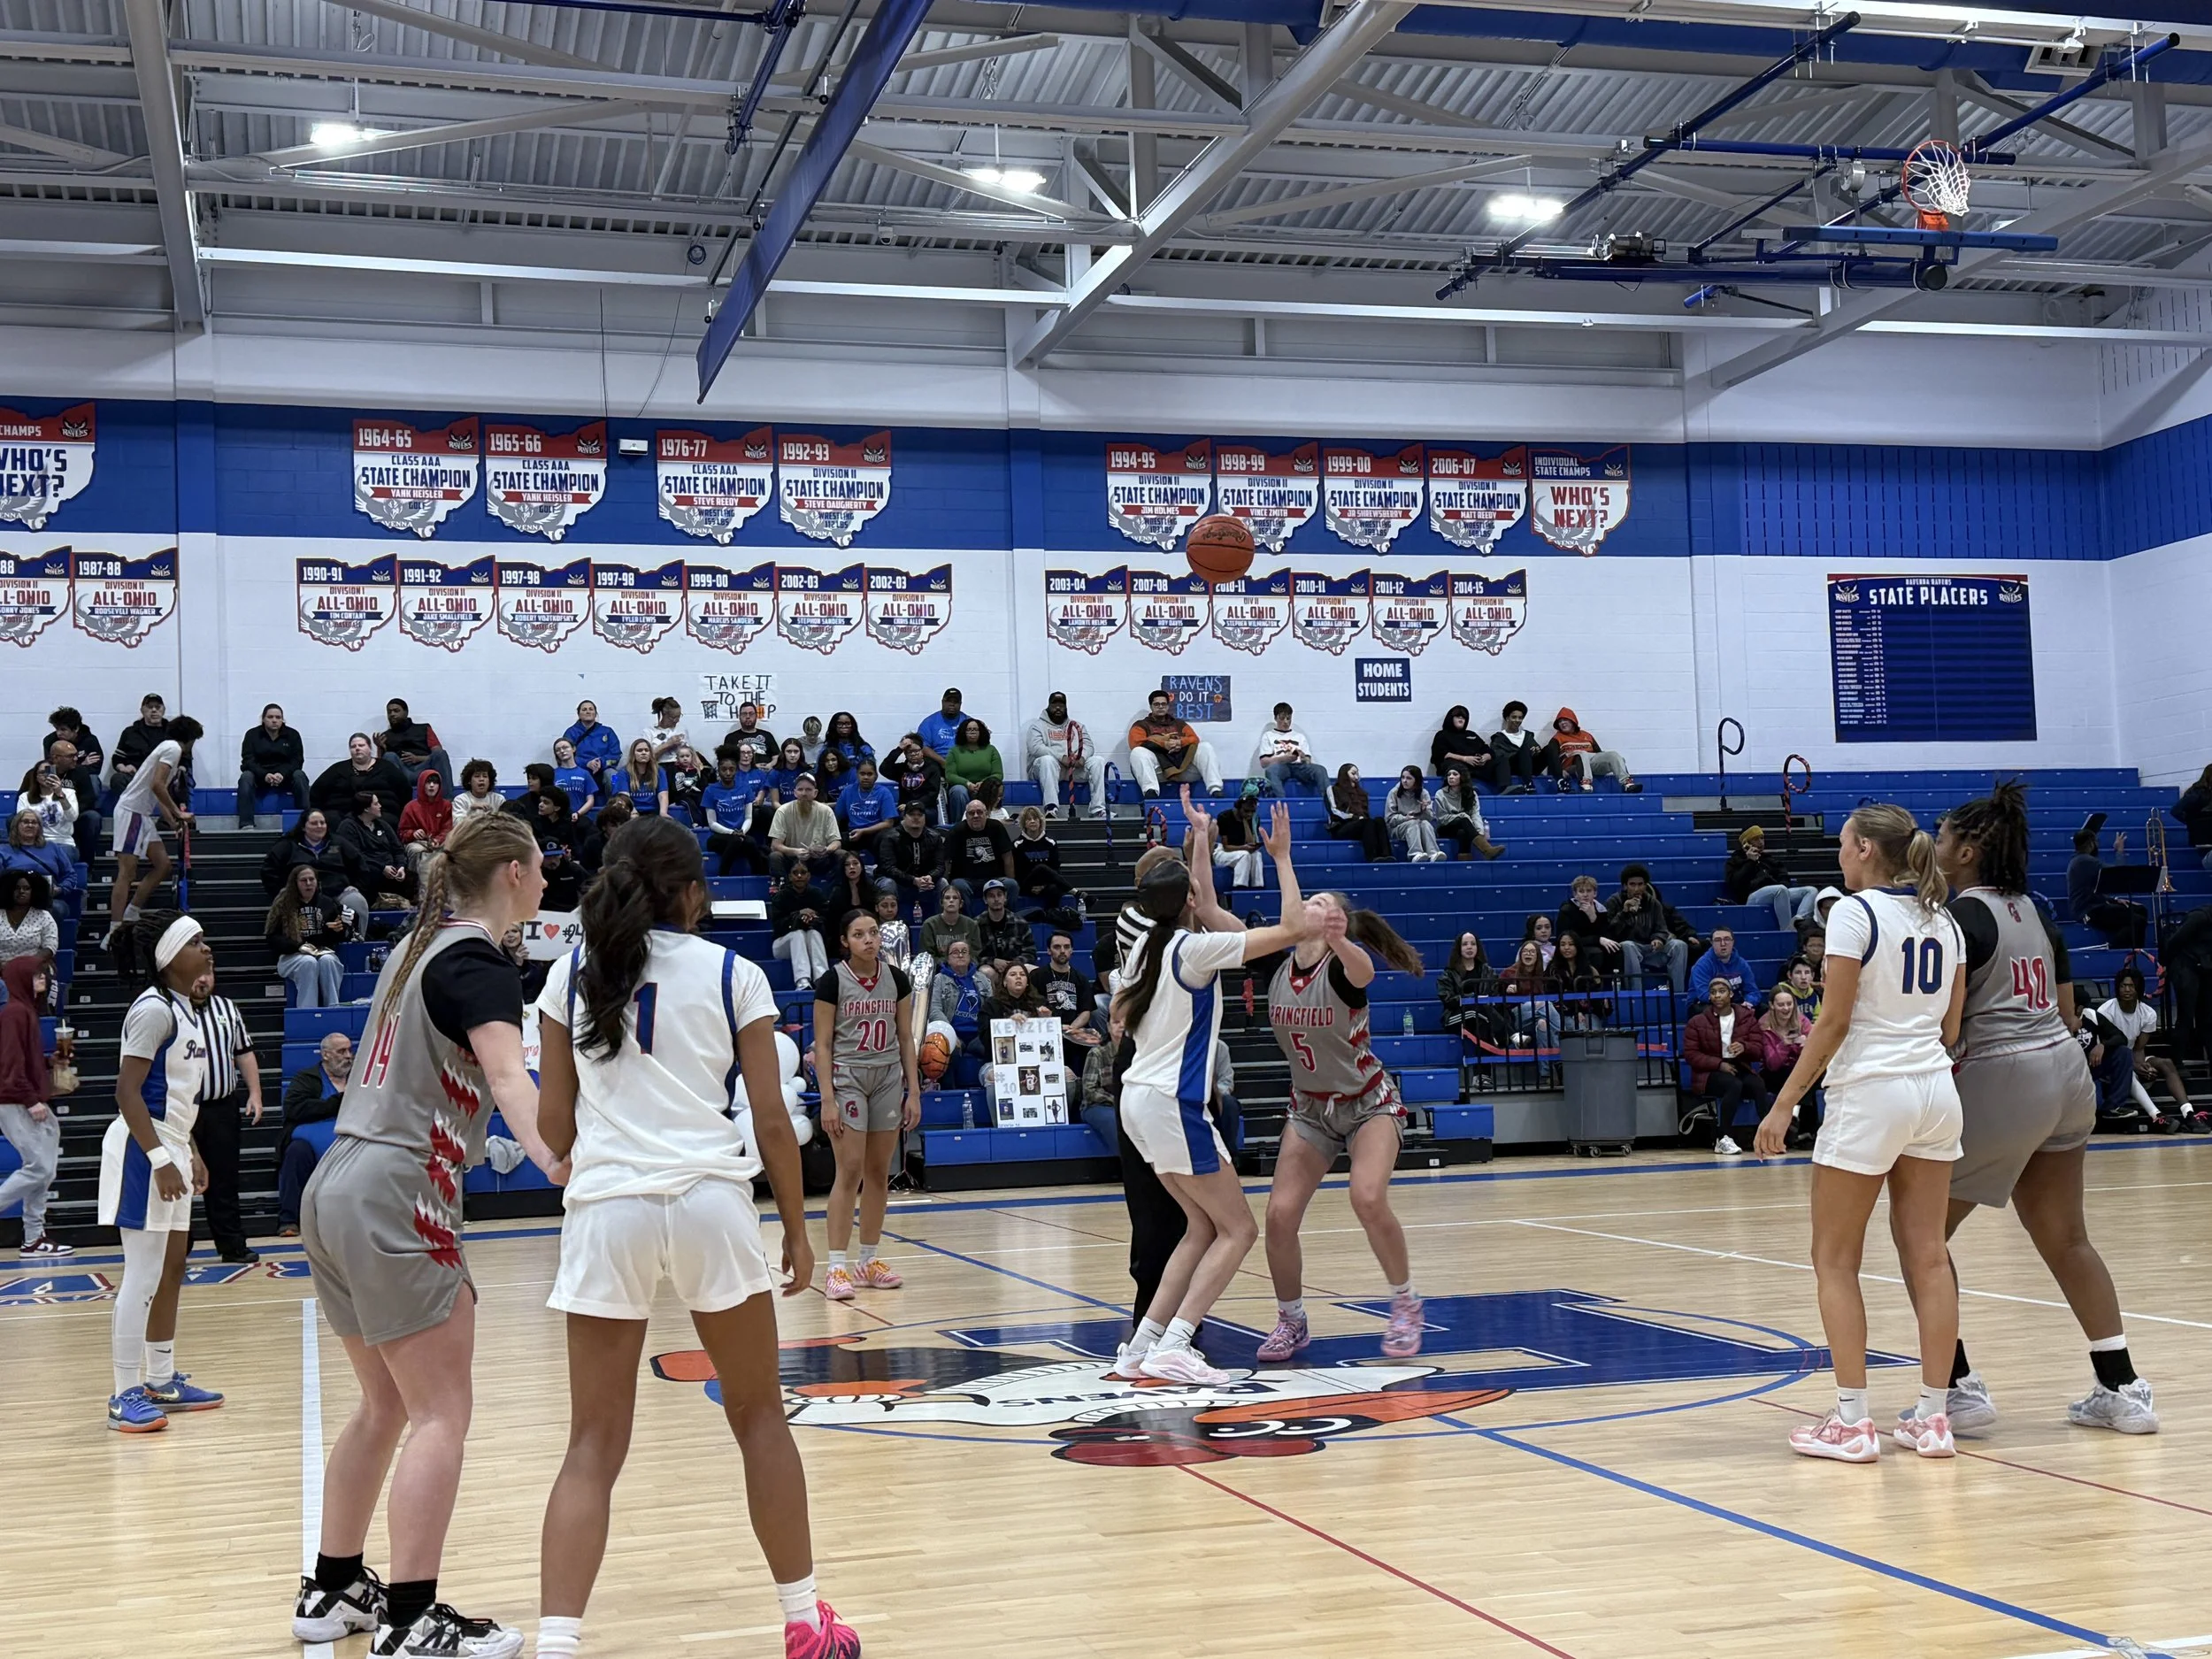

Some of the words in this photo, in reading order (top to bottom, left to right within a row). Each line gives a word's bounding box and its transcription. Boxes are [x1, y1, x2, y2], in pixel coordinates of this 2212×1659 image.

[62, 428, 88, 437] RAVENS
[358, 427, 411, 448] 1964-65
[490, 434, 541, 452] 1965-66
[662, 439, 707, 457] 1976-77
[783, 442, 829, 460] 1992-93
[392, 456, 419, 465] CLASS
[421, 457, 441, 466] AAA
[522, 460, 549, 470] CLASS
[551, 461, 570, 471] AAA
[1111, 451, 1156, 468] 1994-95
[1221, 454, 1264, 471] 1998-99
[1328, 456, 1371, 472] 1999-00
[1432, 458, 1476, 474] 2006-07
[1535, 457, 1578, 466] INDIVIDUAL
[693, 465, 718, 474] CLASS
[720, 465, 737, 475] AAA
[813, 468, 849, 478] DIVISION
[851, 470, 856, 479] II
[1559, 467, 1590, 476] CHAMPS
[362, 467, 399, 486] STATE
[403, 468, 471, 488] CHAMPION
[494, 472, 530, 489] STATE
[534, 472, 598, 491] CHAMPION
[1139, 476, 1173, 485] DIVISION
[1248, 478, 1280, 488] DIVISION
[1283, 479, 1287, 488] II
[1355, 480, 1386, 488] DIVISION
[0, 474, 64, 497] EXT?
[665, 476, 699, 494] STATE
[703, 477, 765, 495] CHAMPION
[787, 480, 819, 497] STATE
[824, 480, 883, 499] CHAMPION
[1459, 481, 1490, 490] DIVISION
[413, 489, 443, 498] HEISLER
[522, 493, 541, 502] YANK
[543, 494, 572, 503] HEISLER
[1114, 487, 1145, 503] STATE
[1148, 488, 1204, 504] CHAMPION
[1224, 489, 1254, 505] STATE
[1257, 490, 1312, 507] CHAMPION
[1331, 491, 1360, 507] STATE
[1363, 491, 1417, 508] CHAMPION
[1435, 492, 1464, 508] STATE
[1468, 493, 1520, 509] CHAMPION
[1550, 487, 1609, 505] WHO'S
[1554, 509, 1608, 528] NEXT?
[79, 561, 121, 575] 1987-88
[303, 567, 342, 580] 1990-91
[404, 569, 442, 582] 1991-92
[502, 571, 540, 584] 1997-98
[597, 572, 634, 586] 1997-98
[690, 573, 728, 588] 1999-00
[781, 574, 818, 588] 2002-03
[871, 575, 906, 589] 2002-03
[105, 581, 138, 590] DIVISION
[1049, 578, 1086, 591] 2003-04
[1133, 579, 1168, 592] 2007-08
[1296, 580, 1325, 593] 2010-11
[1375, 580, 1403, 594] 2011-12
[1454, 580, 1483, 594] 2014-15
[93, 591, 157, 605] ALL-OHIO
[1870, 587, 1914, 605] STATE
[1921, 587, 1988, 605] PLACERS
[318, 596, 377, 611] ALL-OHIO
[418, 598, 476, 611] ALL-OHIO
[516, 599, 572, 613] ALL-OHIO
[611, 601, 666, 614] ALL-OHIO
[703, 602, 757, 616] ALL-OHIO
[795, 603, 848, 617] ALL-OHIO
[883, 603, 934, 617] ALL-OHIO
[1063, 605, 1112, 618] ALL-OHIO
[1145, 605, 1194, 618] ALL-OHIO
[1227, 606, 1275, 619] ALL-OHIO
[1307, 607, 1356, 619] ALL-OHIO
[1387, 607, 1433, 620] ALL-OHIO
[1465, 607, 1512, 620] ALL-OHIO
[1363, 664, 1402, 677] HOME
[704, 675, 750, 690] TAKE
[756, 675, 772, 689] IT
[1170, 676, 1222, 693] RAVENS
[1357, 682, 1409, 697] STUDENTS
[713, 692, 735, 705] TO
[739, 691, 764, 705] THE
[1179, 692, 1193, 702] DO
[1198, 692, 1209, 703] IT
[1177, 703, 1214, 719] BEST
[526, 921, 542, 940] I
[1901, 936, 1943, 995] 10
[2009, 956, 2053, 1011] 40
[633, 981, 658, 1055] 1
[1270, 1004, 1334, 1027] RINGFIELD
[992, 1021, 1054, 1034] KENZIE
[856, 1018, 887, 1052] 20
[360, 1012, 401, 1089] 14
[1289, 1031, 1317, 1072] 5
[1003, 1083, 1016, 1094] 10
